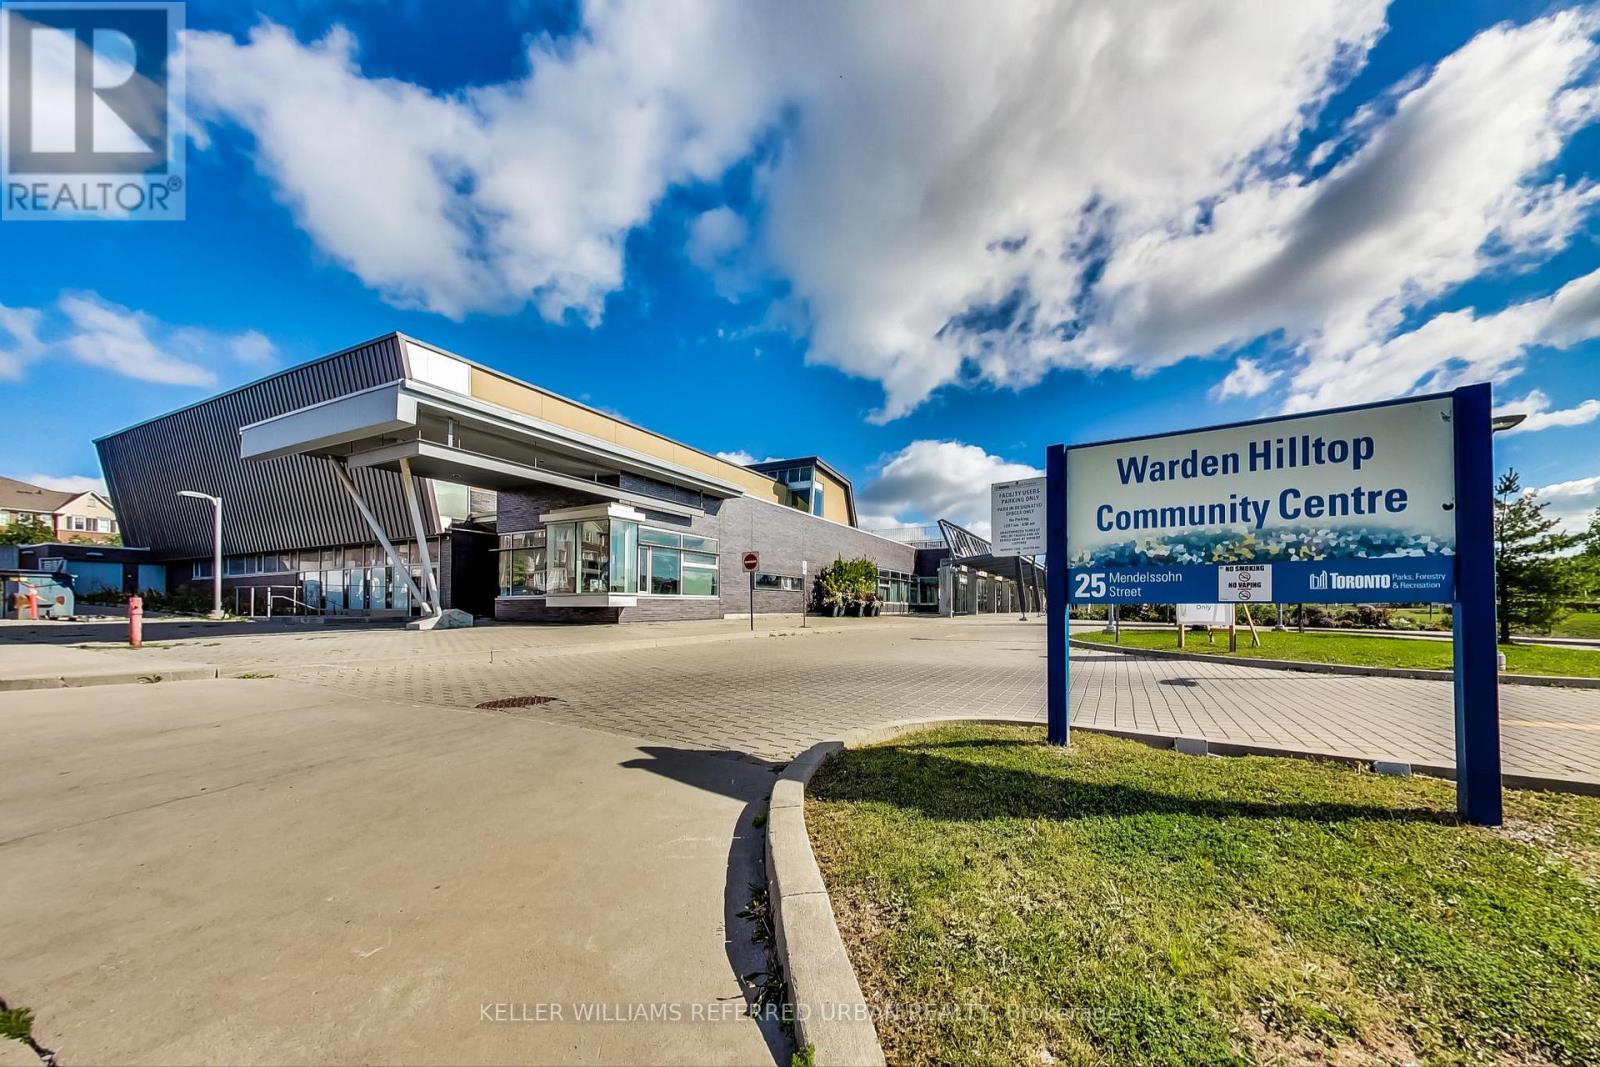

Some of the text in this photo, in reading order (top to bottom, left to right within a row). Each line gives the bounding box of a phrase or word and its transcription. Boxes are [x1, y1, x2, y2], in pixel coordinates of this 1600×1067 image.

[1116, 435, 1375, 485] Warden Hilltop
[1096, 486, 1408, 532] Community Centre
[1109, 571, 1182, 583] Mendelssohn
[1329, 572, 1391, 589] TORONTO
[1415, 572, 1446, 581] Forestry
[1074, 573, 1107, 598] 25
[1109, 586, 1141, 597] Street
[1400, 581, 1441, 589] Recreation
